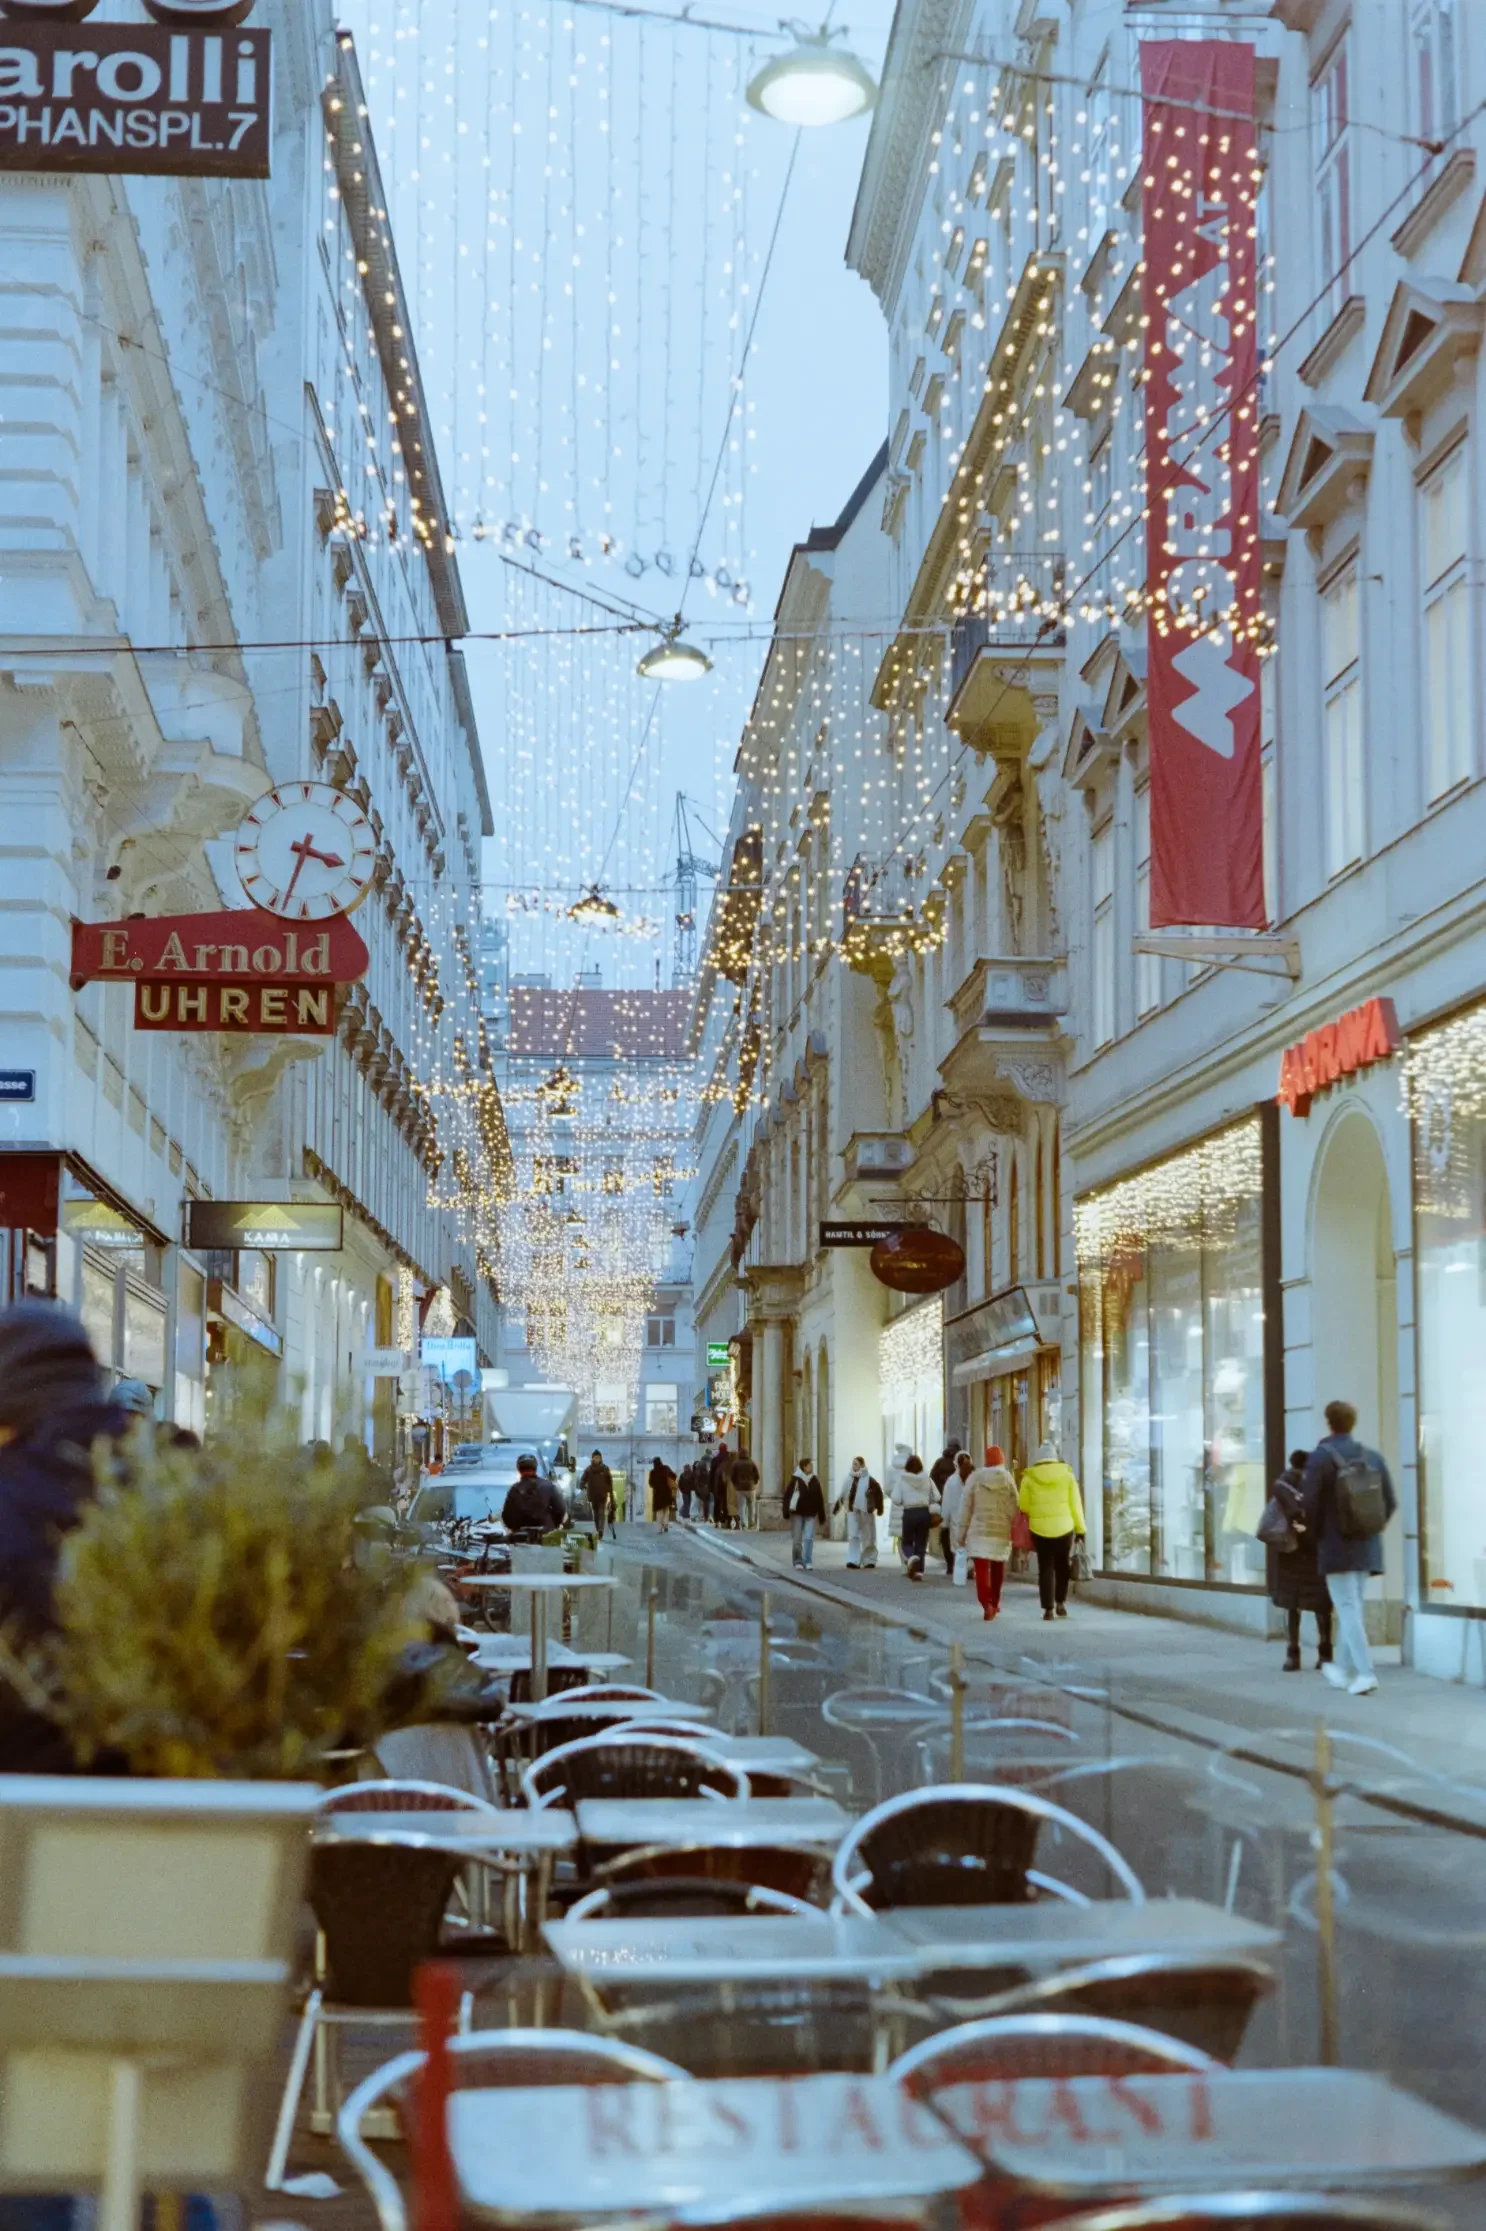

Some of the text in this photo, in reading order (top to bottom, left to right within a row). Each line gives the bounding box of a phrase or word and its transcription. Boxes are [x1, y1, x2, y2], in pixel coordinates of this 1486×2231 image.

[0, 35, 257, 104] arolli
[97, 929, 332, 975] E. Arnold
[140, 984, 328, 1027] UHREN
[584, 2075, 1215, 2160] RESTAURANT
